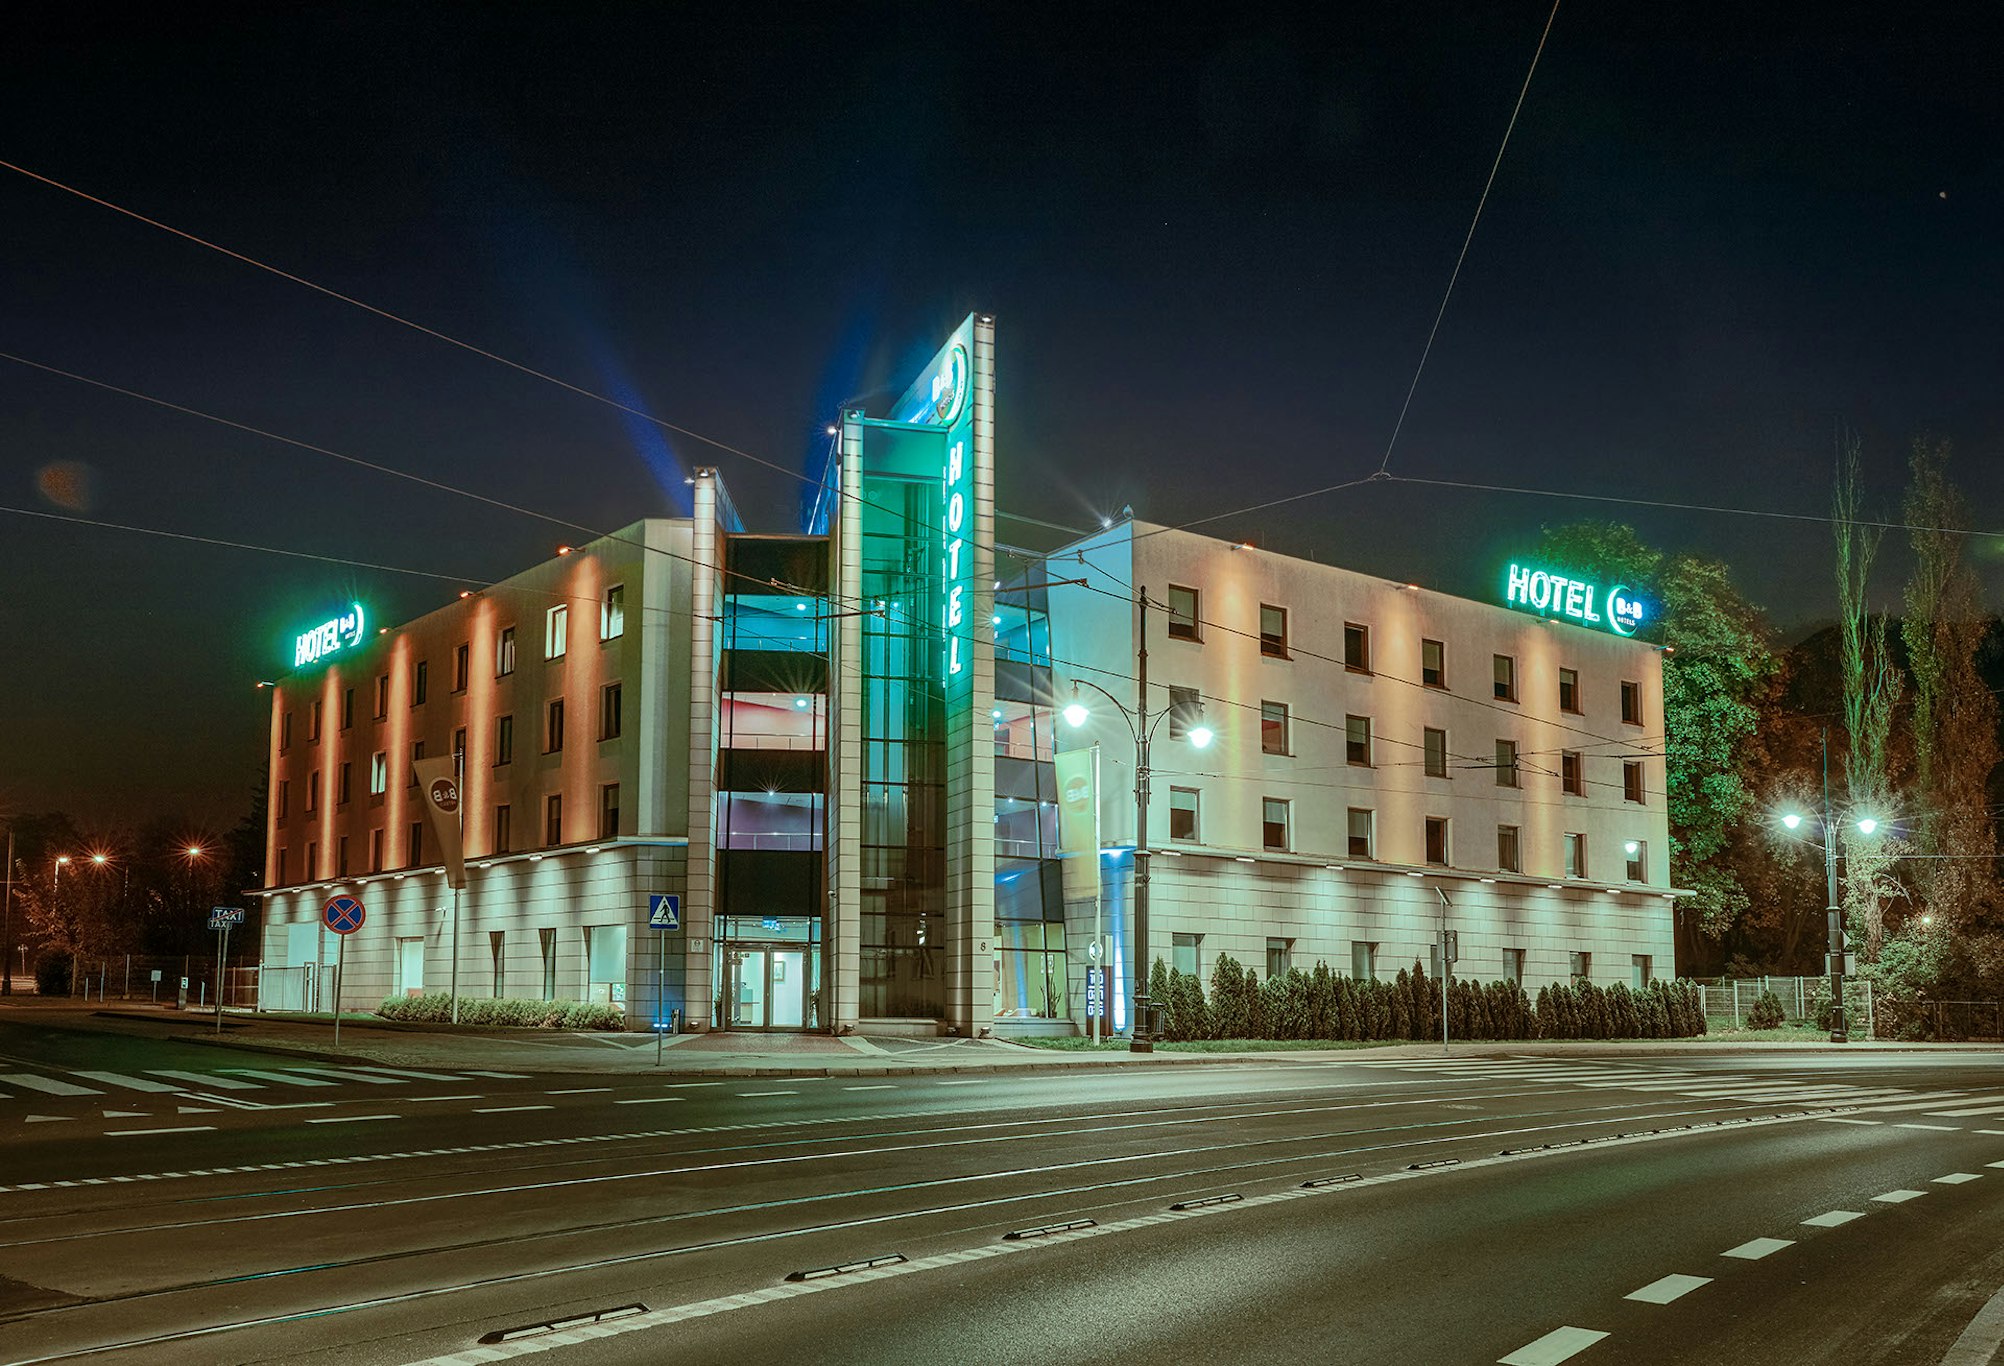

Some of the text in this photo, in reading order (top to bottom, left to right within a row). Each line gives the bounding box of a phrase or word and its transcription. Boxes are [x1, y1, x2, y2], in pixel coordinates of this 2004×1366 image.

[948, 441, 964, 675] HOTEL
[1507, 563, 1601, 622] HOTEL
[1616, 597, 1643, 620] B&B
[294, 617, 341, 667] HOTEL
[210, 920, 230, 928] TAX
[215, 909, 242, 921] TAXI
